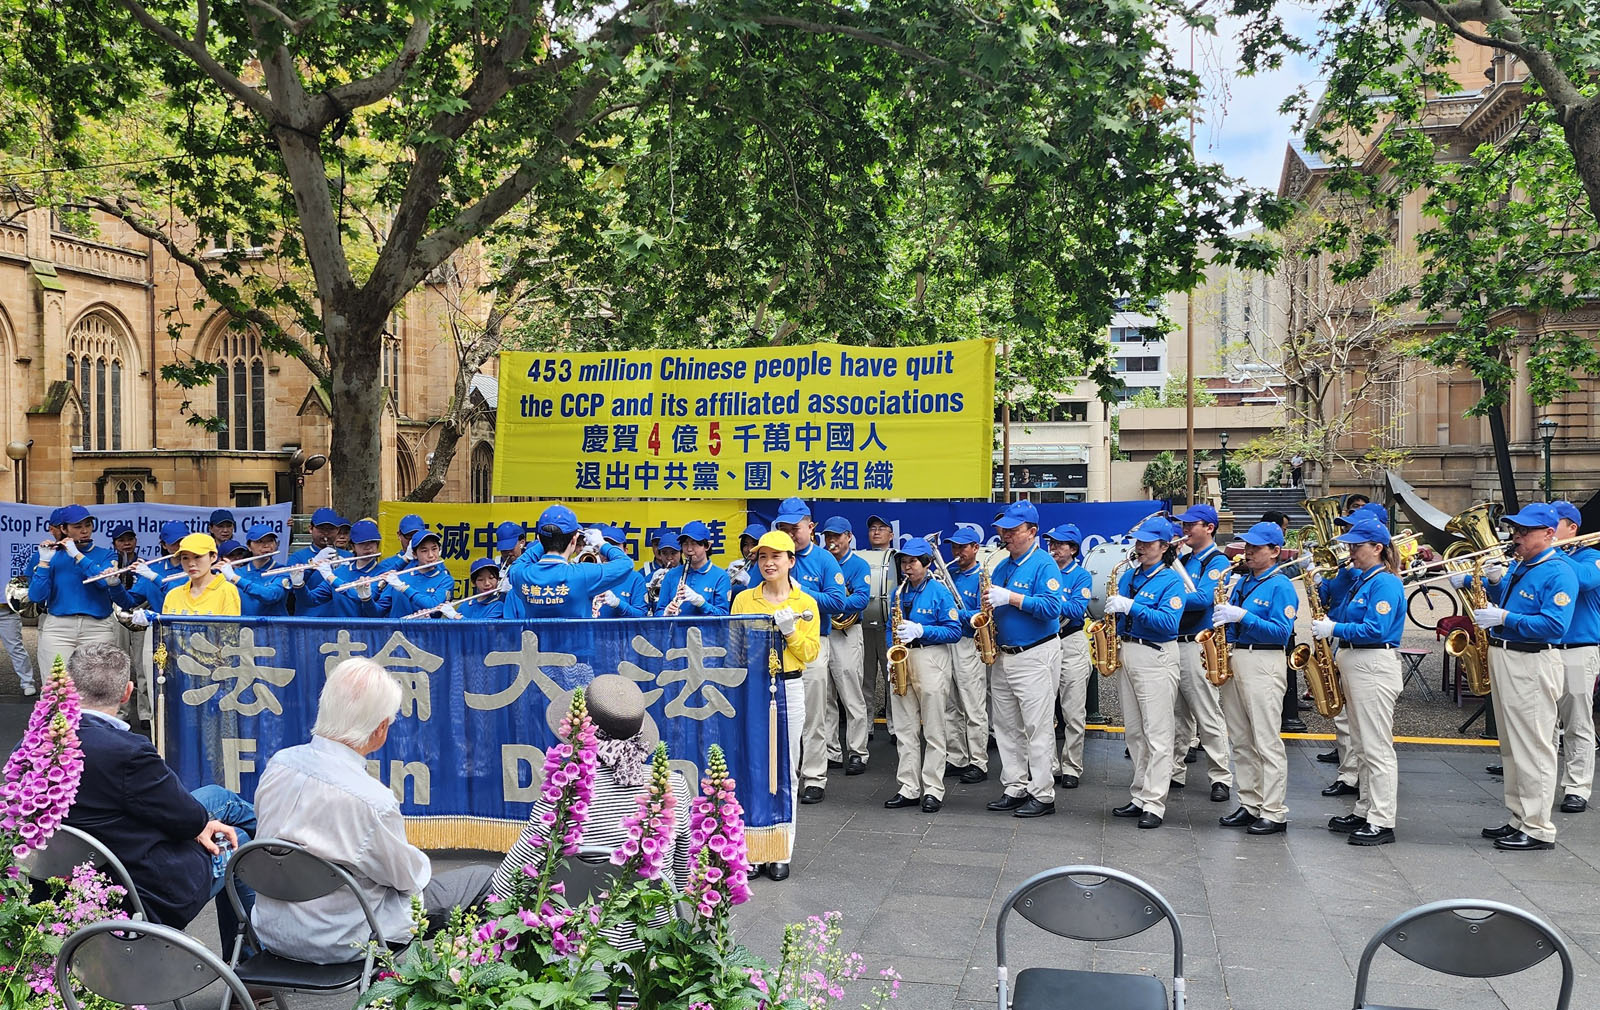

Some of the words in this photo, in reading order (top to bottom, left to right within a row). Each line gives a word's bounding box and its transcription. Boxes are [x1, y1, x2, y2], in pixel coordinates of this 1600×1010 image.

[527, 359, 572, 383] 453
[578, 357, 653, 382] million
[659, 356, 747, 381] Chinese
[754, 351, 832, 384] people
[840, 351, 898, 378] have
[906, 350, 955, 382] quit
[520, 393, 554, 418] the
[560, 392, 605, 418] CCP
[611, 392, 654, 417] and
[660, 392, 689, 417] its
[694, 388, 800, 417] affiliated
[807, 388, 964, 416] associations
[581, 421, 888, 457] 慶賀4億5千萬中國人
[575, 459, 894, 491] 退出中共黨、團、隊組織
[0, 515, 32, 537] Stop
[521, 583, 570, 597] 法輪大法
[526, 596, 544, 605] Falun
[545, 596, 564, 605] Dafa
